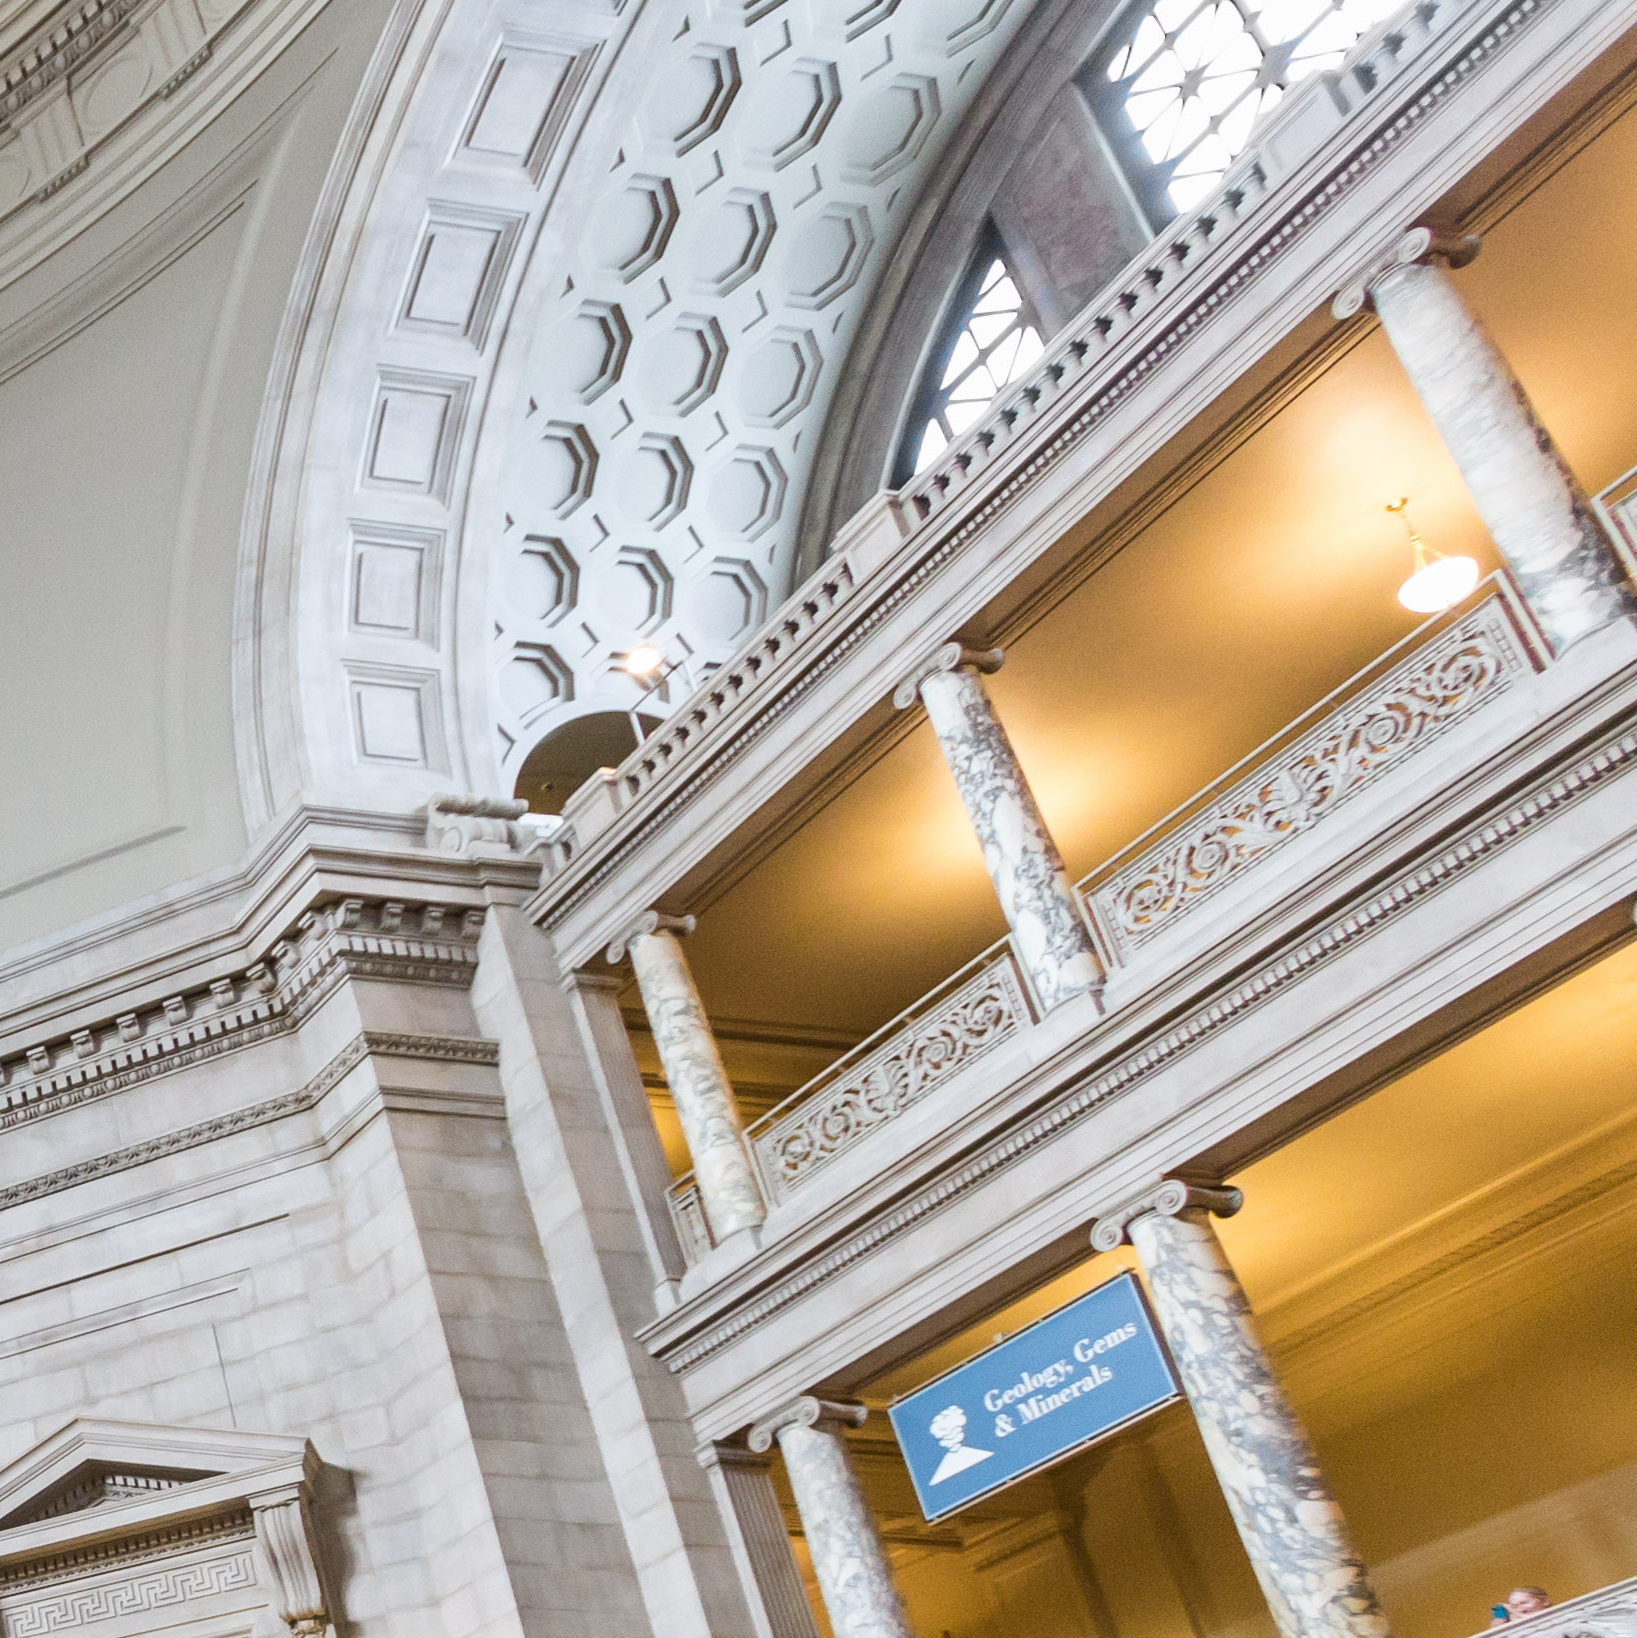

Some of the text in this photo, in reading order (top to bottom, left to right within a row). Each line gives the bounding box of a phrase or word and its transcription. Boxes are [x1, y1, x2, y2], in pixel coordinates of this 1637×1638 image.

[984, 1322, 1137, 1412] Geology, Gems
[995, 1364, 1113, 1438] & Minerals
